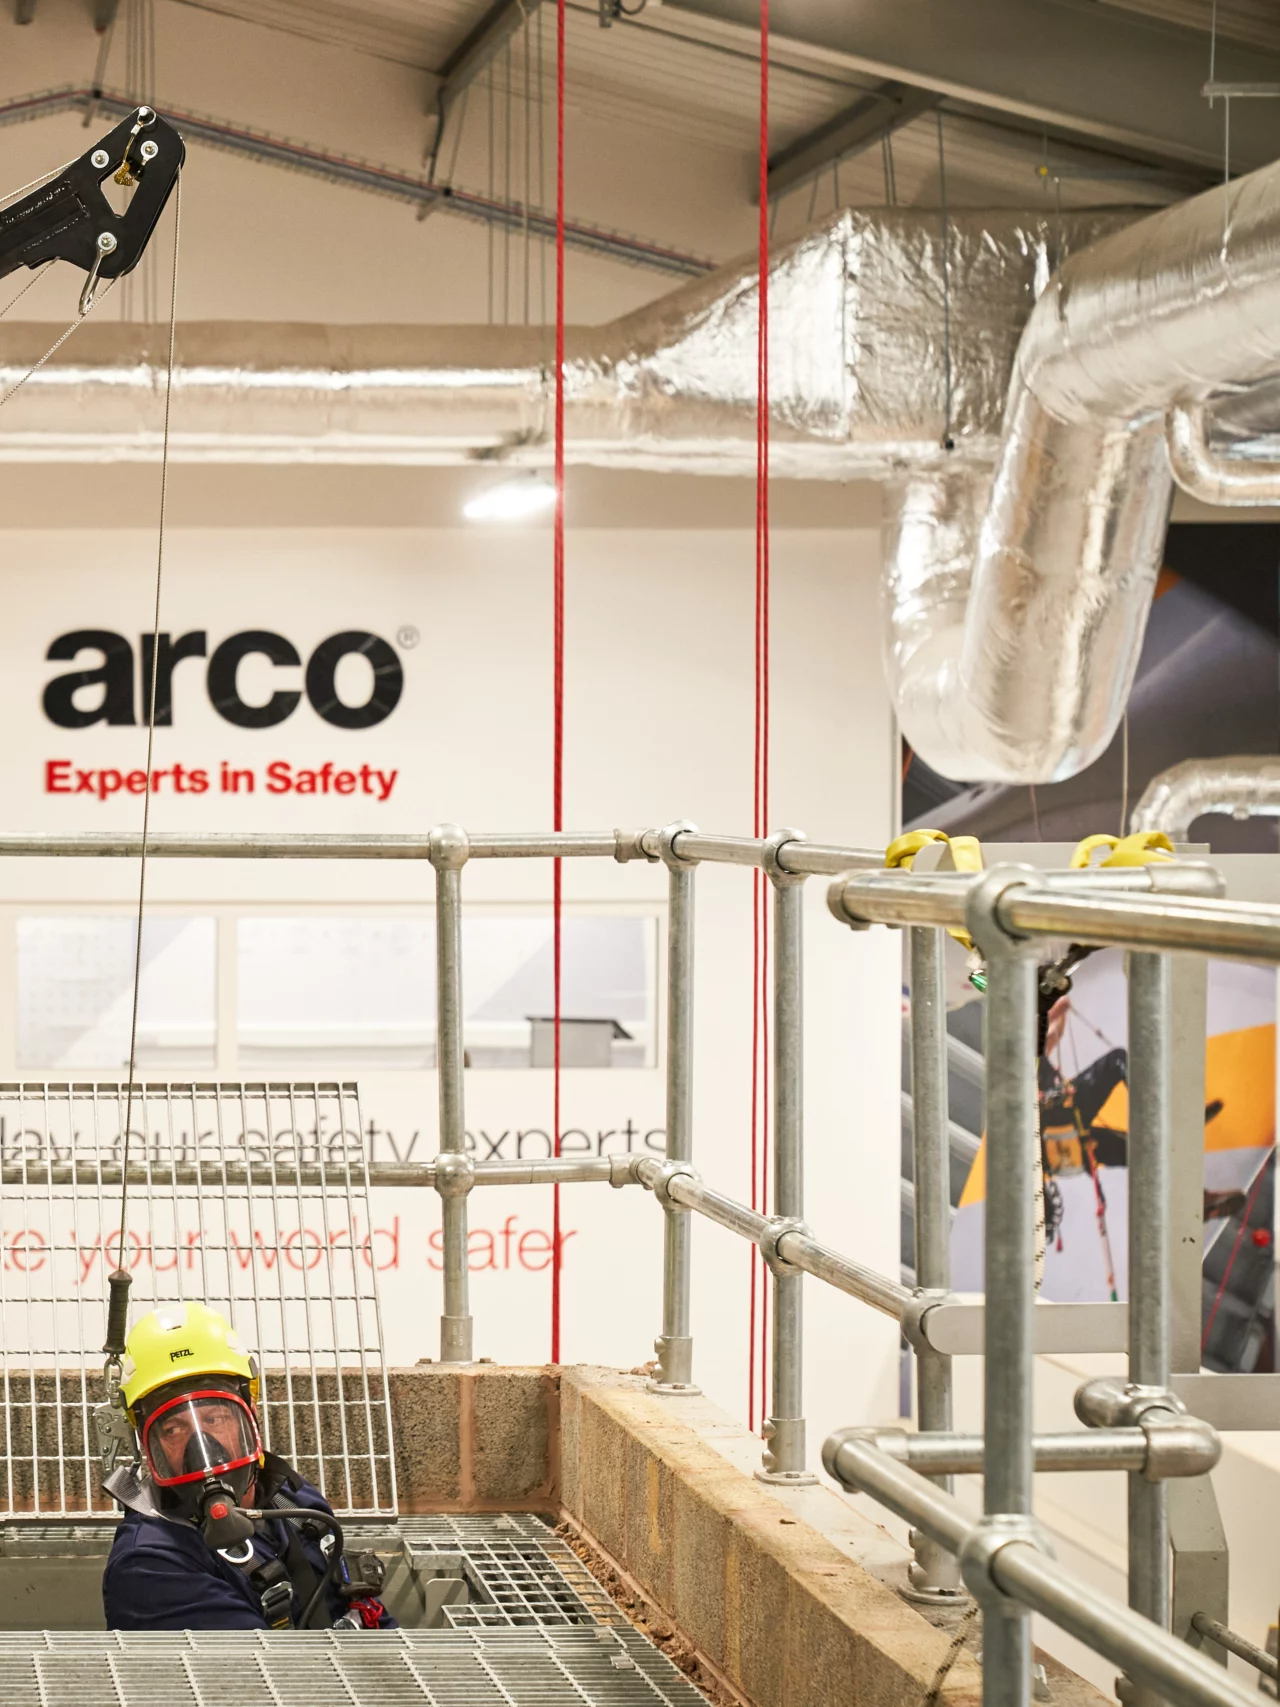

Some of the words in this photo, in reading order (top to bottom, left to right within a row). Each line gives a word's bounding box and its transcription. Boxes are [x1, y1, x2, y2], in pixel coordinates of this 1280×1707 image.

[41, 629, 404, 730] arco
[44, 760, 210, 800] Experts
[220, 761, 255, 793] in
[266, 761, 398, 800] Safety
[112, 1129, 214, 1166] our
[70, 1229, 206, 1285] your
[170, 1349, 194, 1362] PETZL
